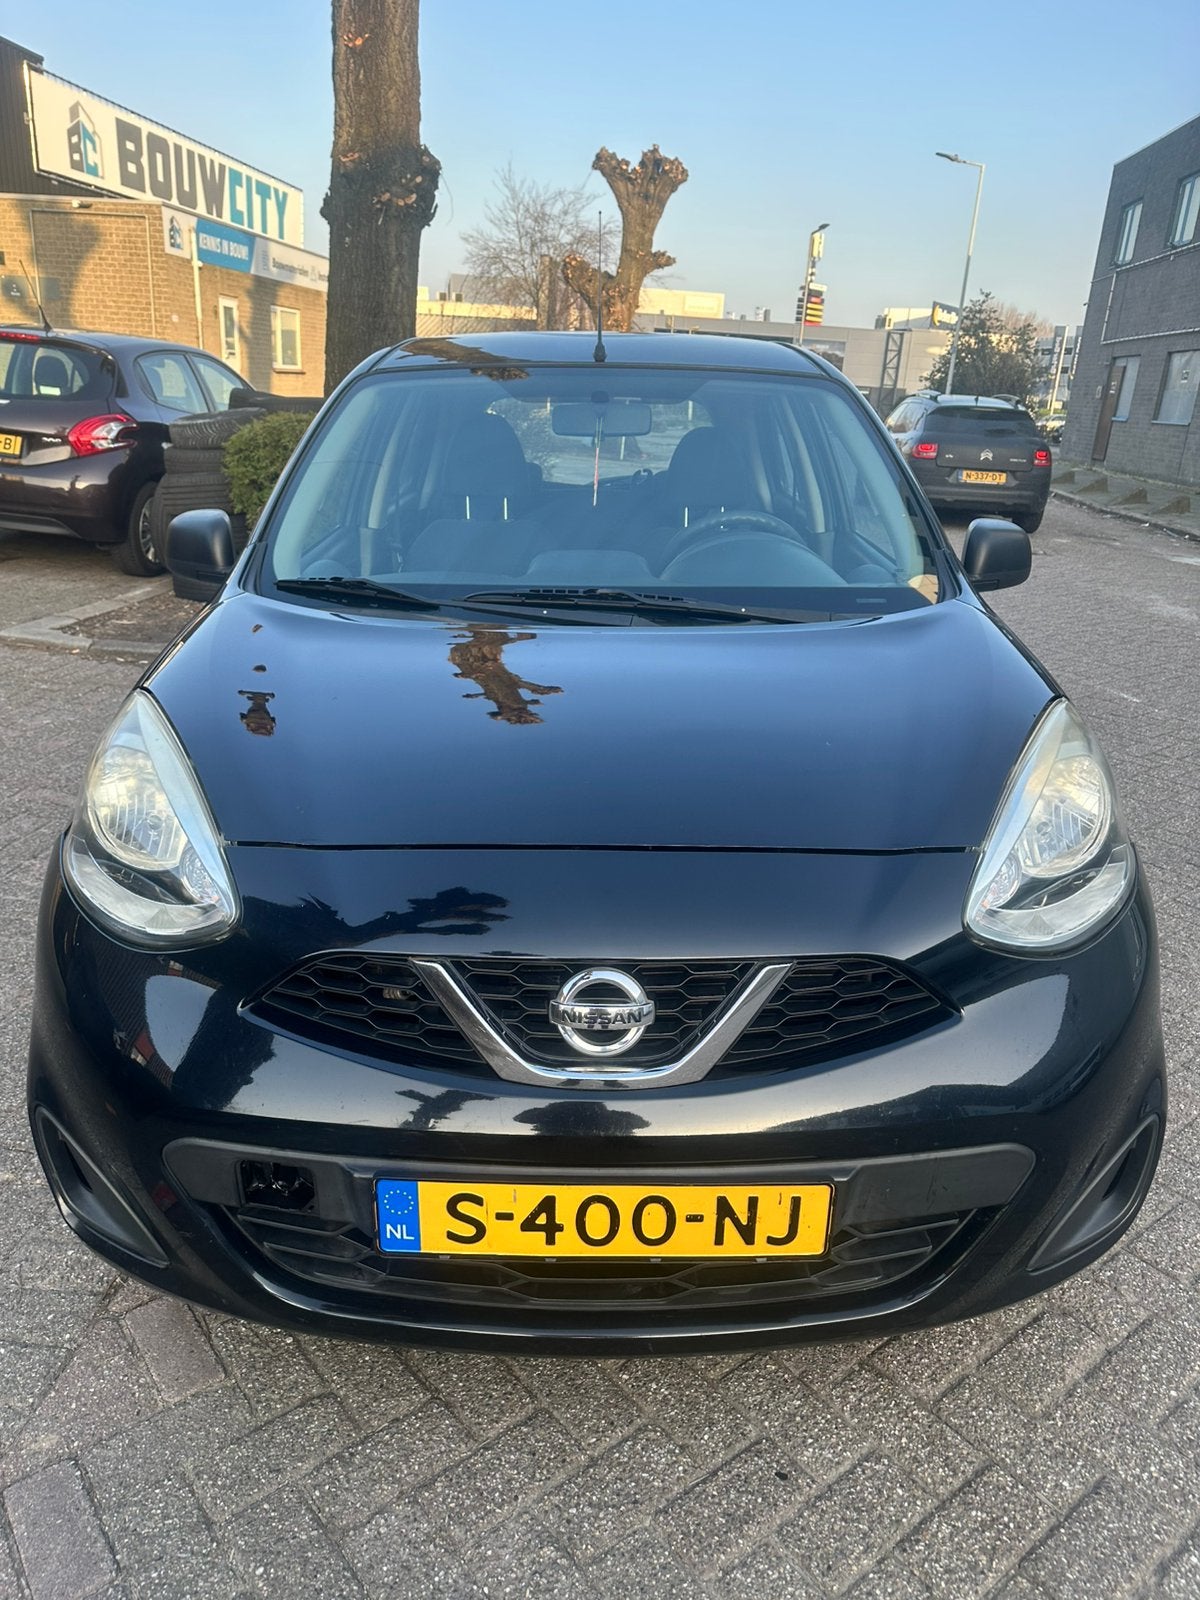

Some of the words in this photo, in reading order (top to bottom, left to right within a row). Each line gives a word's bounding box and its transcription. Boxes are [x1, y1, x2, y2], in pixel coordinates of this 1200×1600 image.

[115, 116, 288, 240] BOUWCITY
[965, 472, 1004, 481] N-337-DT
[561, 1007, 642, 1025] NISSAN
[446, 1193, 801, 1247] S-400-NJ
[386, 1224, 415, 1241] NL
